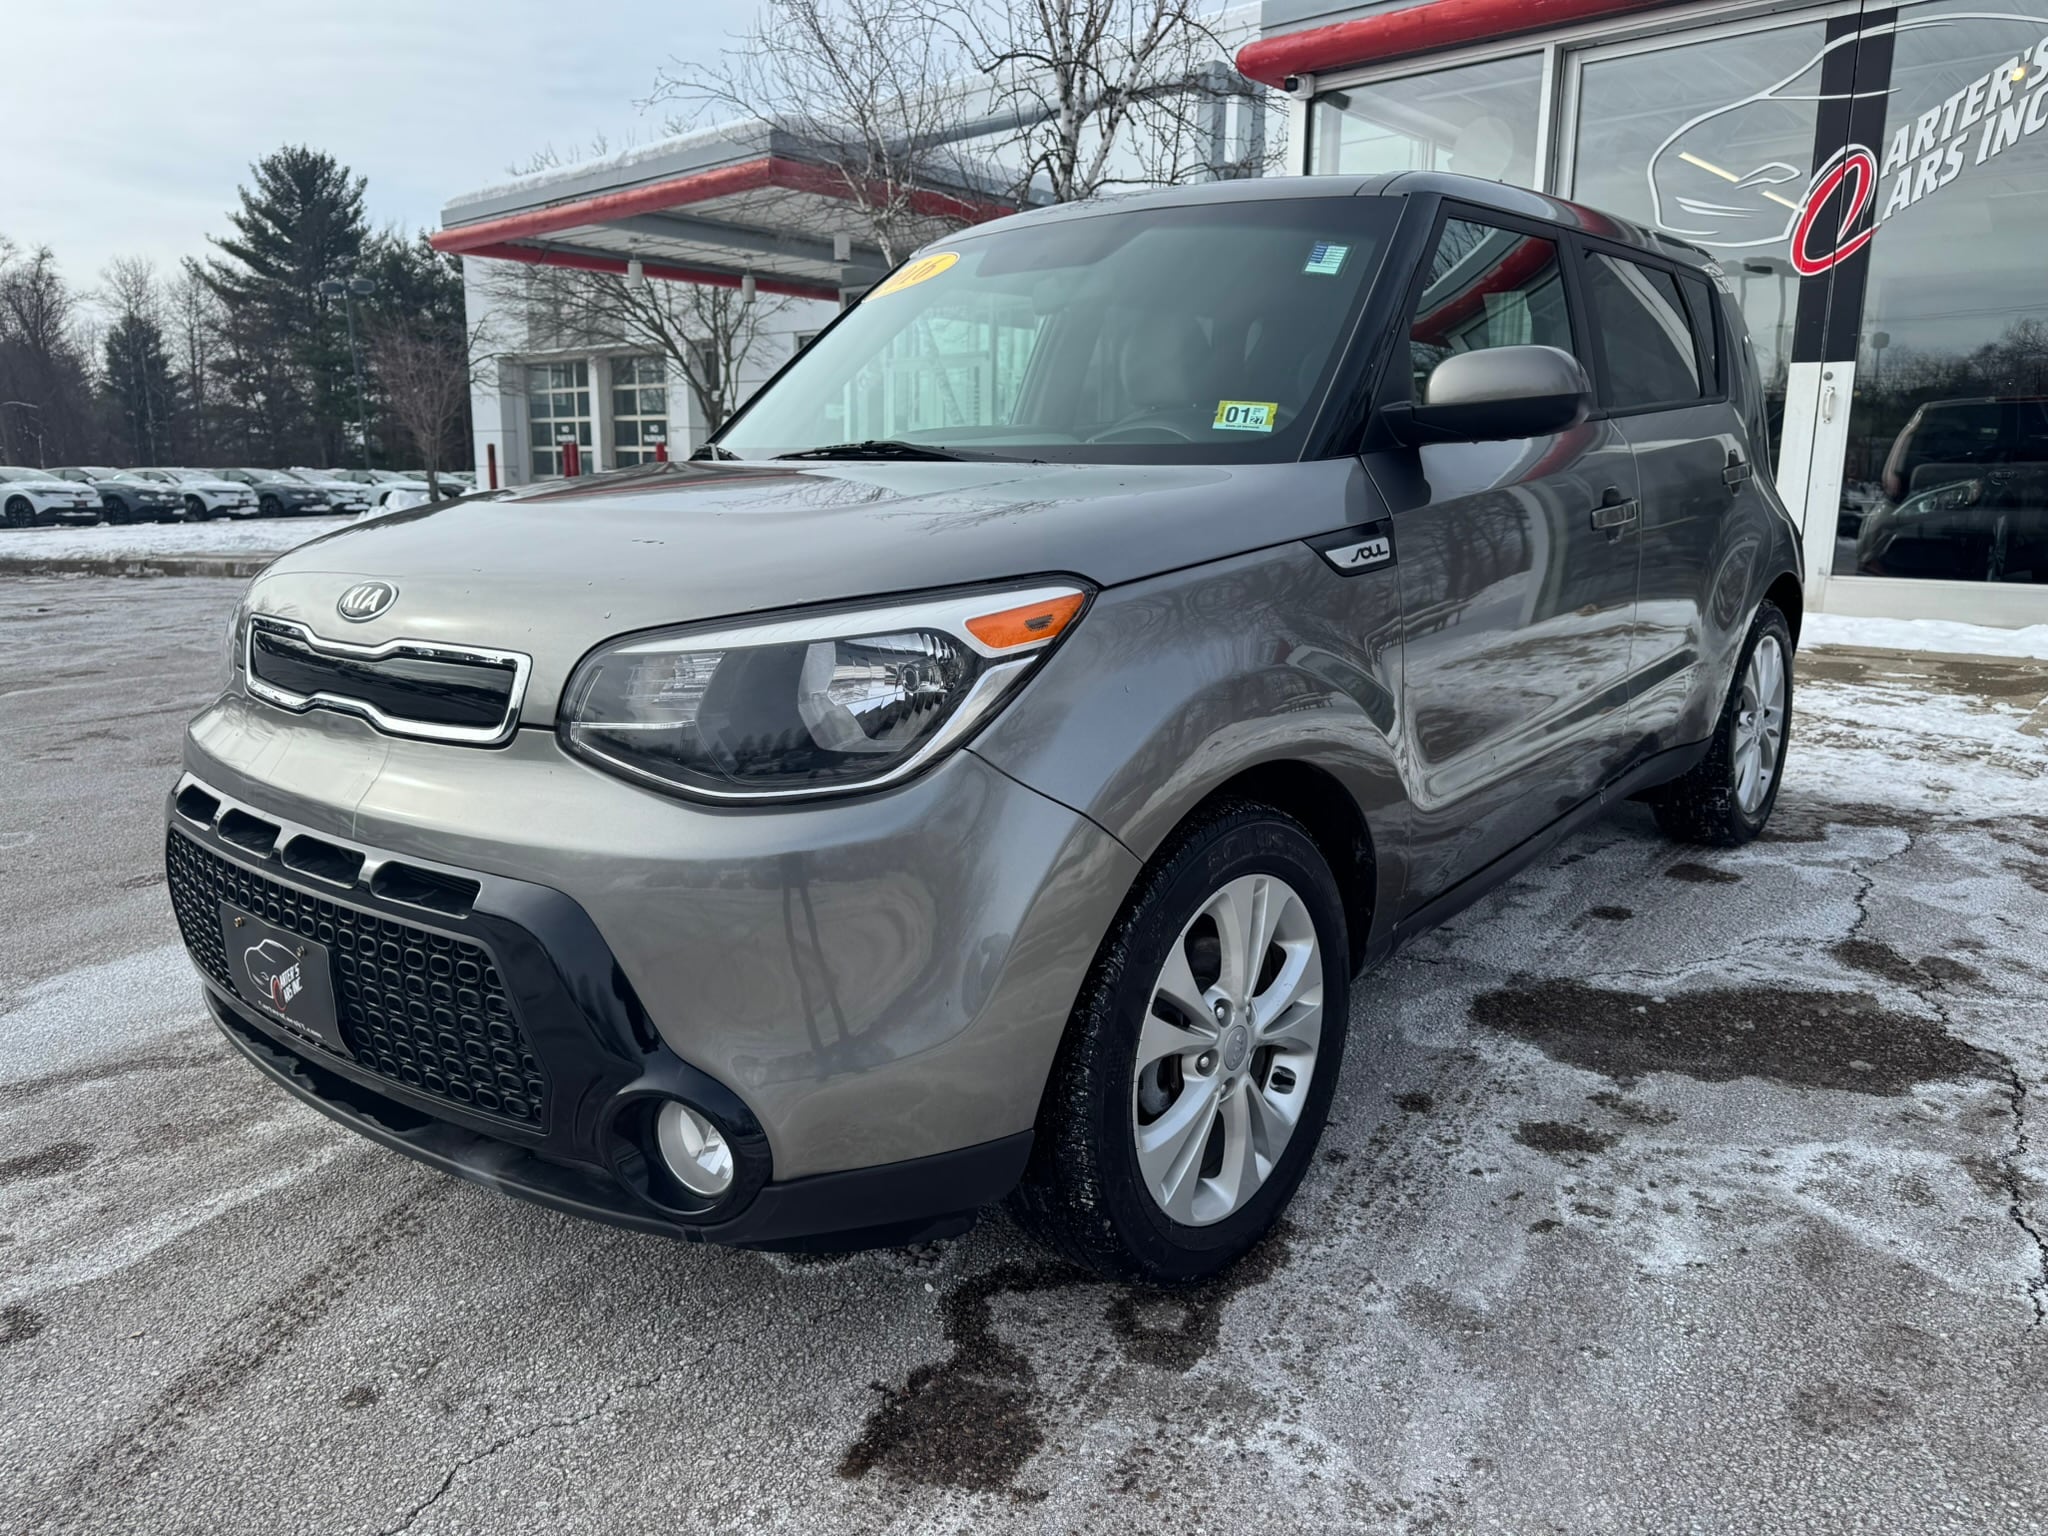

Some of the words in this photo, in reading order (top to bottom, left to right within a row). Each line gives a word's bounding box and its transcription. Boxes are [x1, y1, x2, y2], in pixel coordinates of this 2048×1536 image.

[1225, 406, 1250, 424] 01
[1350, 543, 1389, 563] SOUL
[342, 586, 385, 612] KIA
